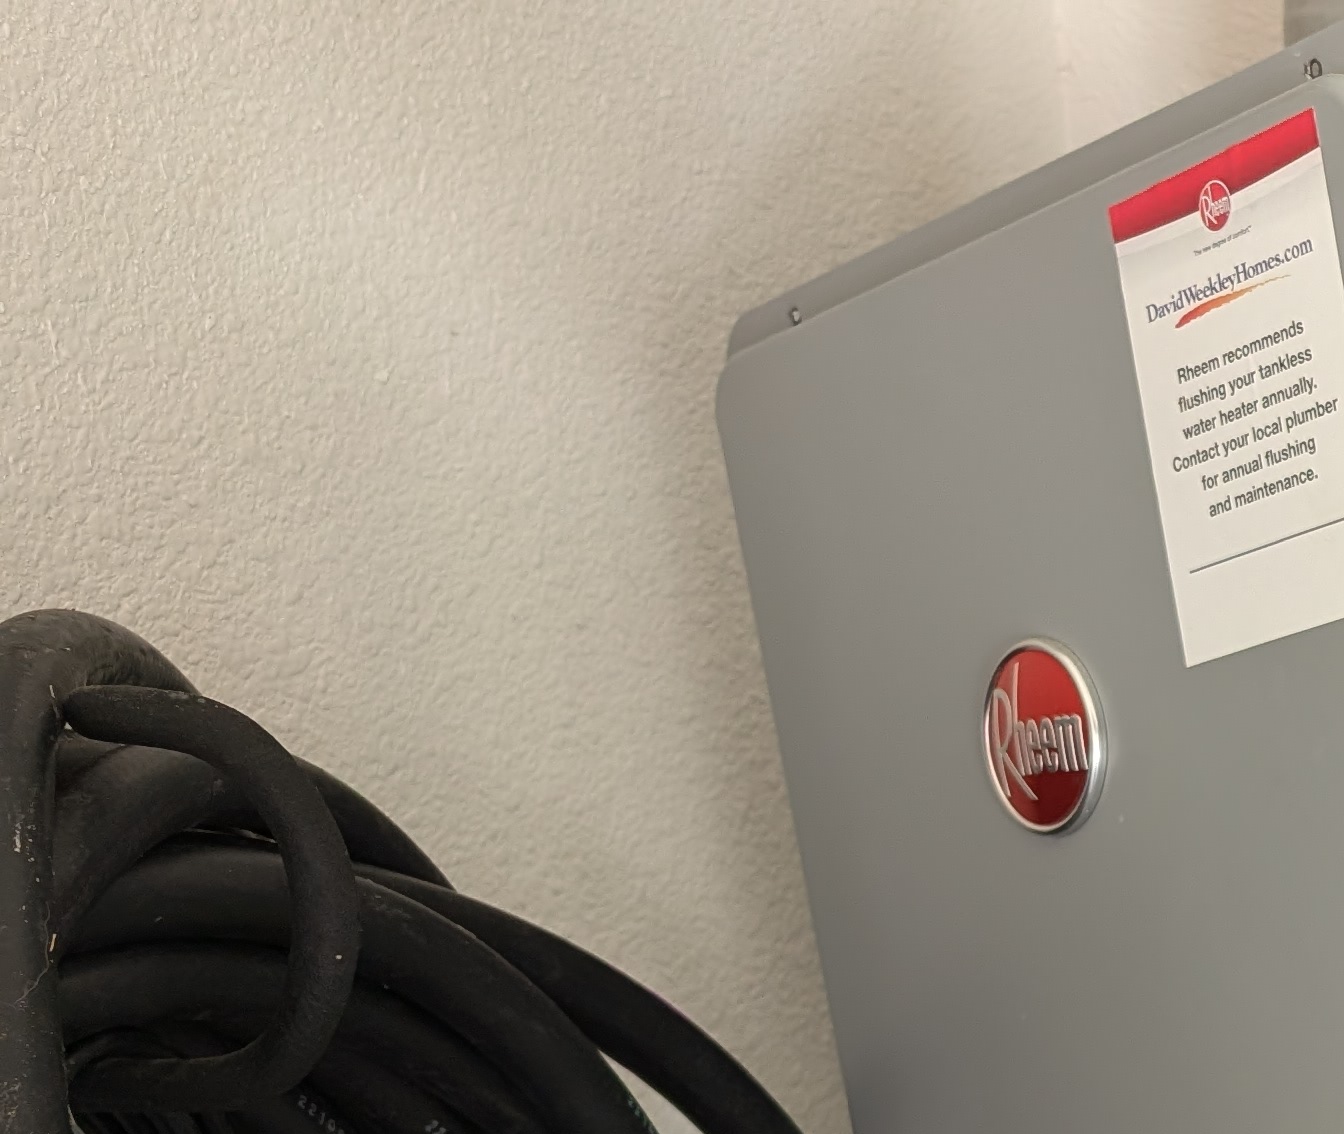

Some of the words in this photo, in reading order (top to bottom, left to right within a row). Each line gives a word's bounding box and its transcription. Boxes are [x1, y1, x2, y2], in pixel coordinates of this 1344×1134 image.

[1145, 238, 1313, 323] DavidWeekleyHomes.com
[1177, 356, 1220, 384] Rheem
[1222, 320, 1304, 365] recommends
[1178, 382, 1226, 413] flushing
[1228, 371, 1256, 396] your
[1258, 348, 1313, 380] tankless
[1172, 444, 1220, 472] Contact
[1221, 433, 1250, 458] your
[1252, 417, 1283, 443] local
[1285, 397, 1339, 433] plumber
[1182, 416, 1217, 440] water
[1219, 400, 1259, 427] heater
[1261, 376, 1317, 408] annually.
[1201, 473, 1219, 491] for
[1222, 454, 1263, 484] annual
[1265, 437, 1316, 467] flushing
[1208, 496, 1232, 517] and
[1234, 468, 1318, 509] maintenance.
[990, 661, 1090, 800] Rheem
